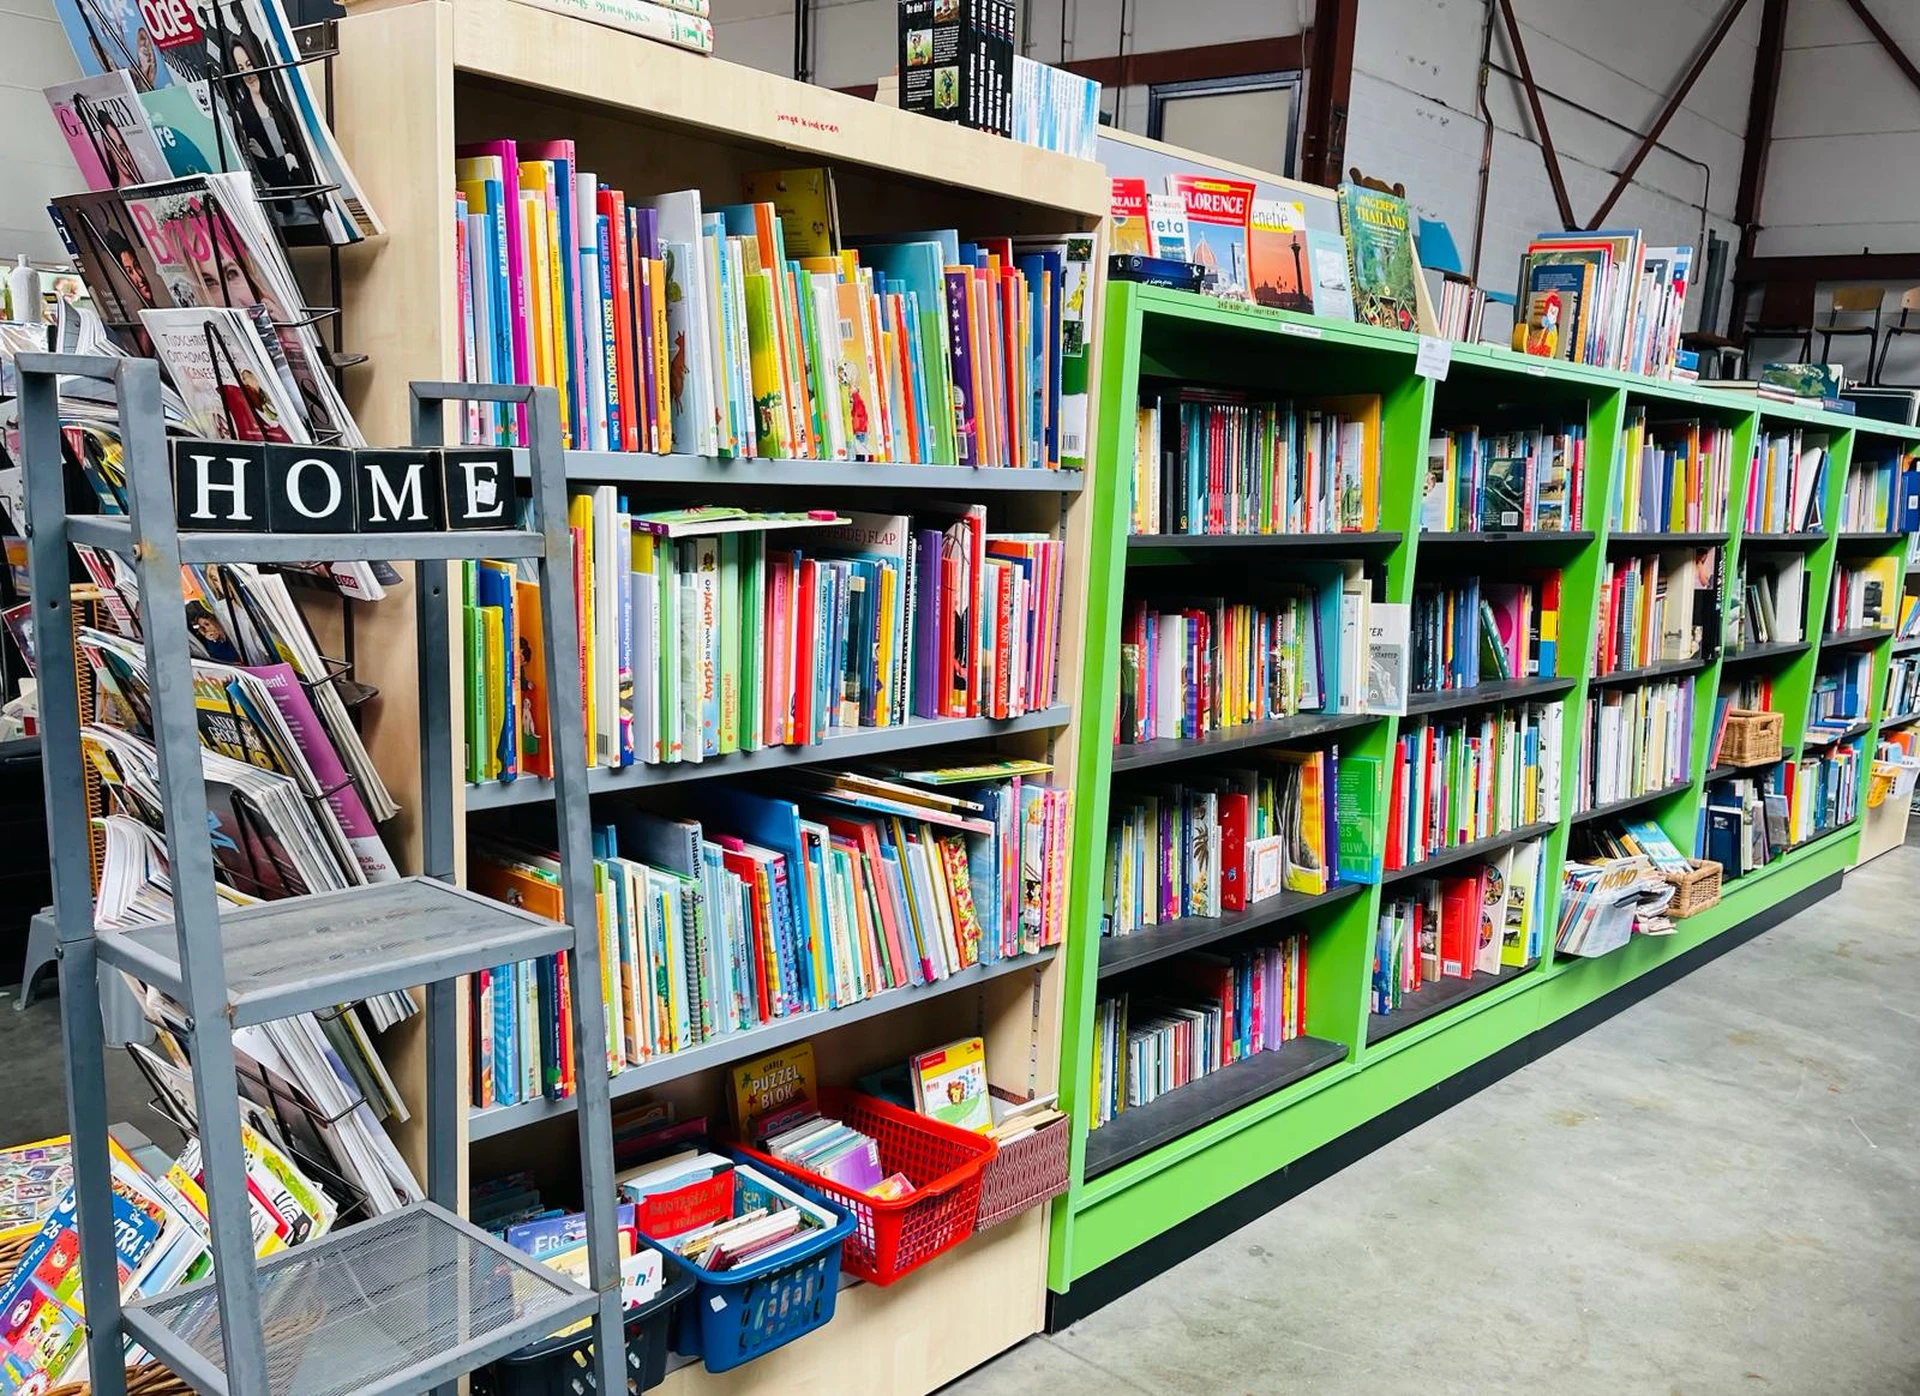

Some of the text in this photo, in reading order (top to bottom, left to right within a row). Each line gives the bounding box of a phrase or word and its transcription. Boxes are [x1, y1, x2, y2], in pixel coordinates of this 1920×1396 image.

[1181, 191, 1244, 214] FLORENCE
[1355, 206, 1405, 231] THAILAND
[600, 225, 610, 263] RICHARD
[602, 264, 612, 295] SCARRY
[603, 298, 615, 341] EERSTE
[605, 344, 619, 405] SPROOKJES
[189, 454, 504, 522] HOME
[868, 530, 896, 546] FLAP
[704, 591, 713, 628] JACHT
[704, 661, 713, 701] SCHAT
[752, 1064, 800, 1093] PUZZEL
[761, 1084, 794, 1110] BLOK
[43, 1220, 61, 1239] 26
